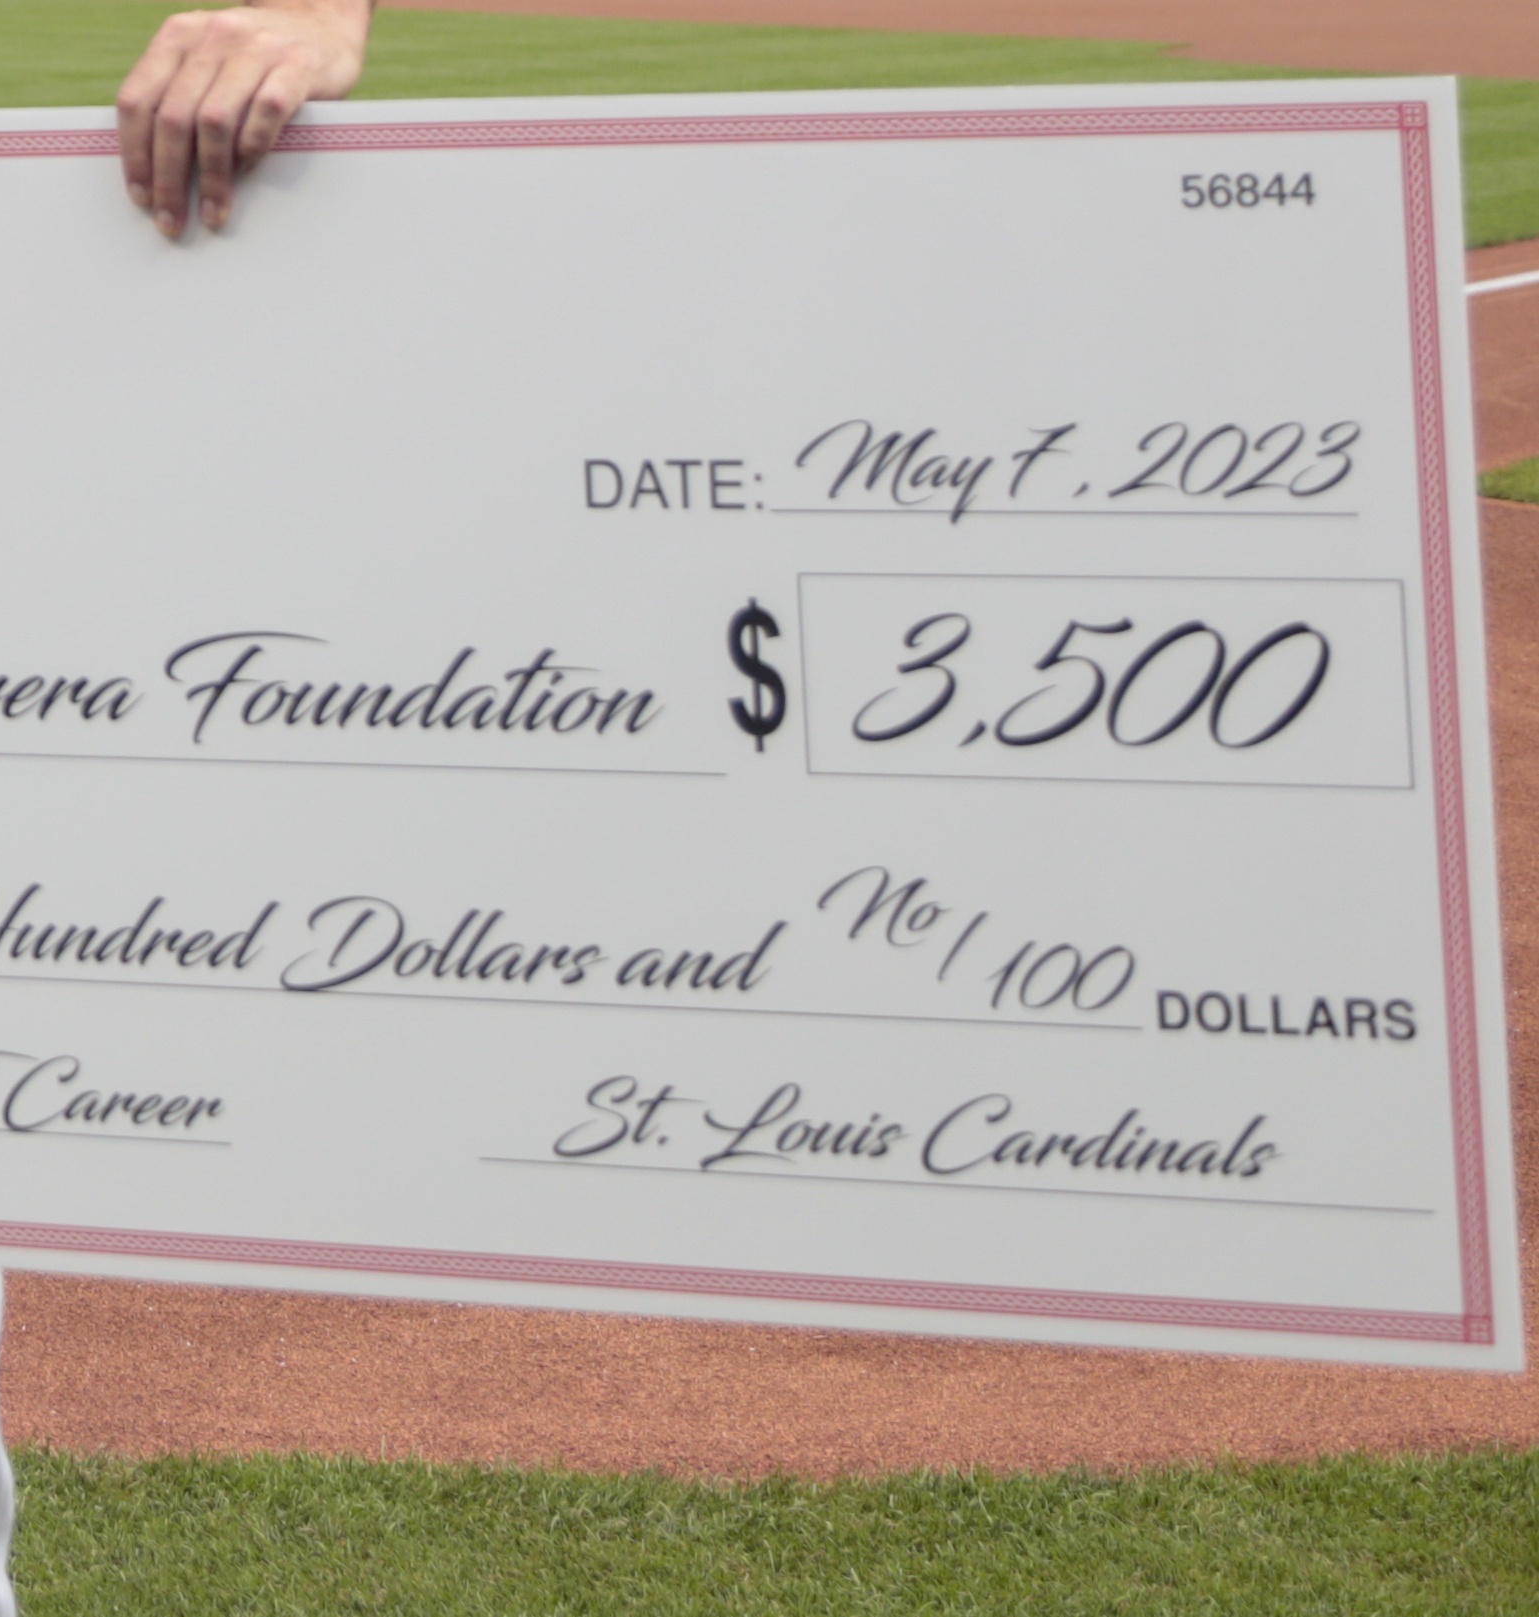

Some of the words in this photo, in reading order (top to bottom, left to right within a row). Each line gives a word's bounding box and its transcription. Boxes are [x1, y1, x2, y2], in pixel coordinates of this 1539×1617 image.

[1179, 172, 1316, 210] 56844
[583, 458, 765, 513] DATE:
[795, 418, 995, 524] May
[1107, 420, 1362, 501] 2023
[164, 630, 666, 746] Foundation
[726, 597, 788, 753] $
[852, 610, 1332, 751] 3,500
[279, 895, 607, 992] Dollars
[615, 920, 790, 992] and
[1156, 989, 1418, 1043] DOLLARS
[3, 1054, 225, 1134] Career
[553, 1074, 687, 1161] St.
[700, 1083, 908, 1171] Louis
[922, 1093, 1280, 1180] Cardinals
